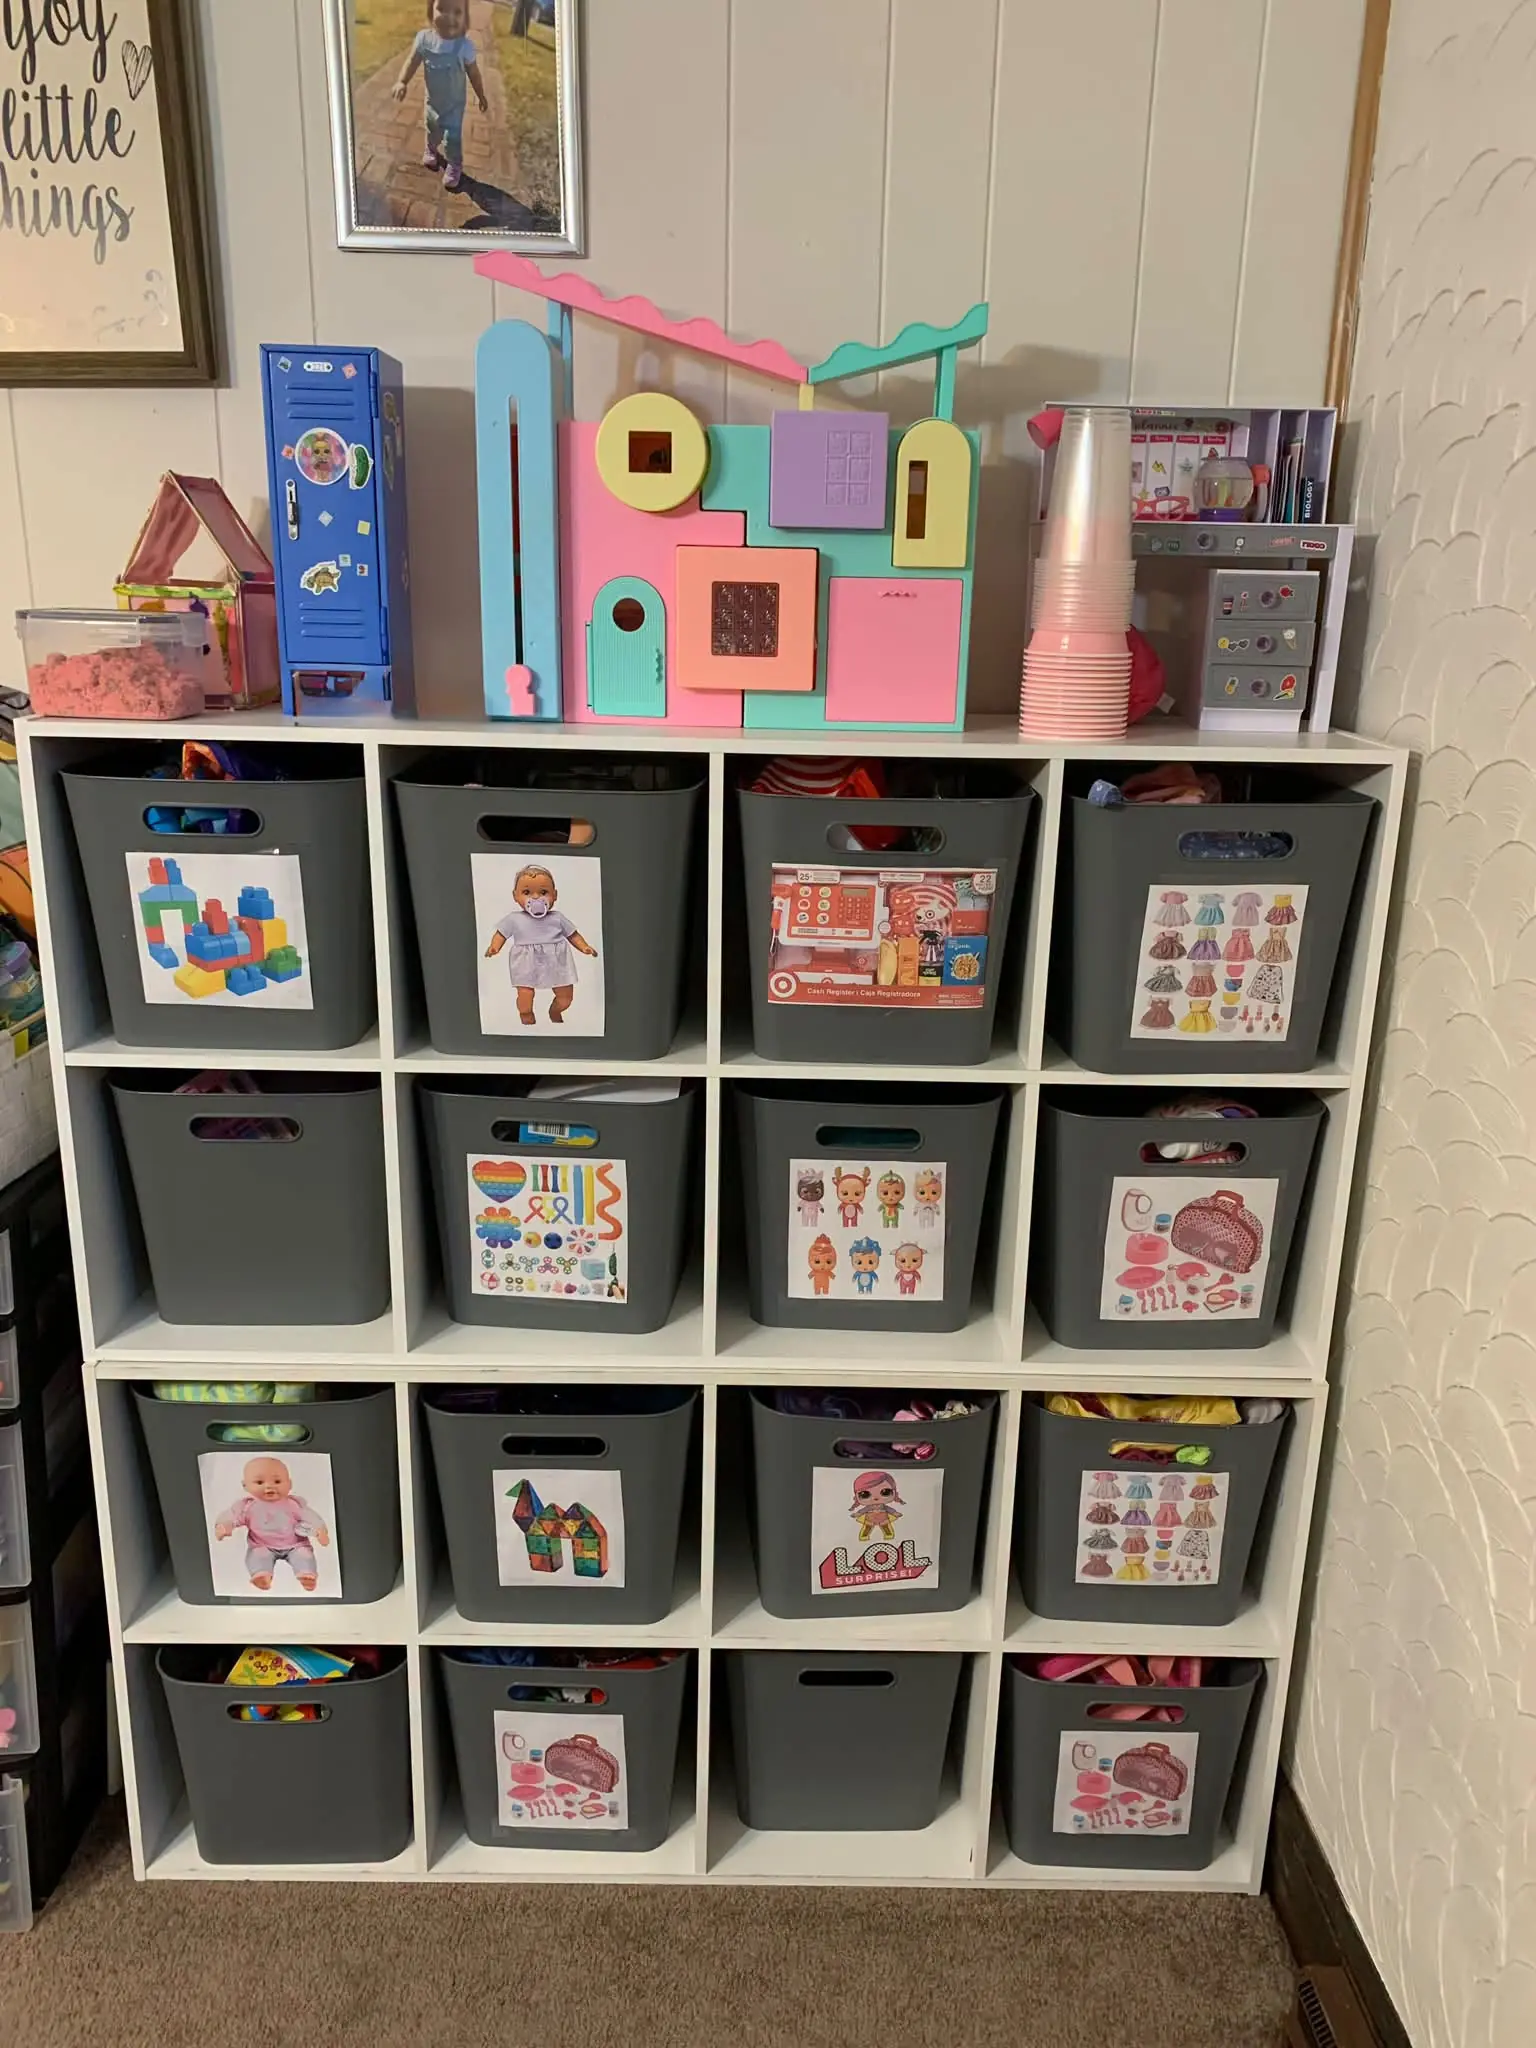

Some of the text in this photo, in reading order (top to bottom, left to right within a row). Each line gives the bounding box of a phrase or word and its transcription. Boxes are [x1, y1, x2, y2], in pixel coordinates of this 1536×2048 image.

[2, 84, 135, 163] little
[0, 161, 135, 265] hings
[1304, 480, 1313, 519] BIOLOGY
[979, 875, 992, 883] 22
[807, 987, 921, 998] Cash Register Caja Registradora
[835, 1569, 913, 1585] SURPRISE!
